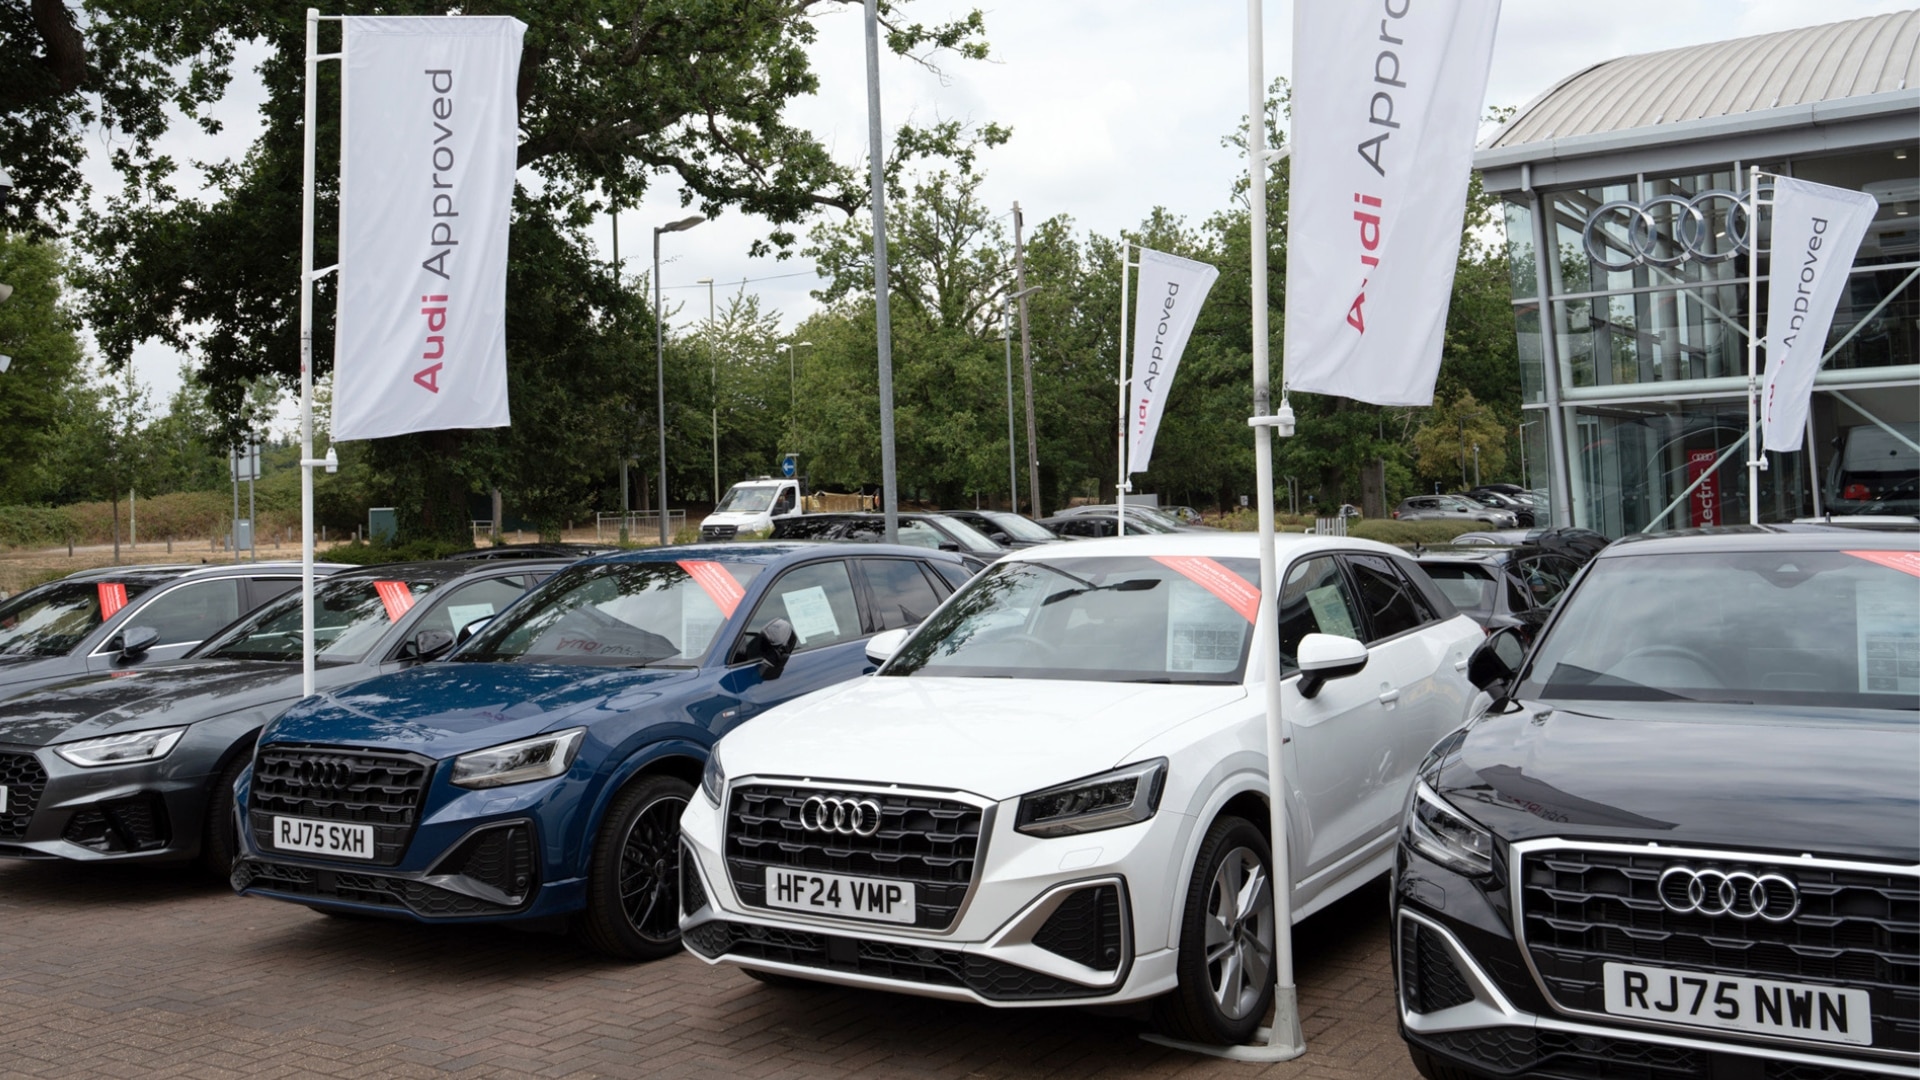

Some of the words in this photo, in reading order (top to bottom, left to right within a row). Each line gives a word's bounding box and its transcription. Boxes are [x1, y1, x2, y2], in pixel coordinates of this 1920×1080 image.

[422, 69, 459, 280] Approved
[413, 295, 448, 394] Audi
[1144, 282, 1179, 392] Approved
[282, 821, 324, 848] RJ75
[330, 826, 364, 853] SXH
[777, 873, 841, 908] HF24
[850, 881, 902, 914] VMP
[1623, 970, 1739, 1020] RJ75
[1754, 984, 1848, 1033] NWN
